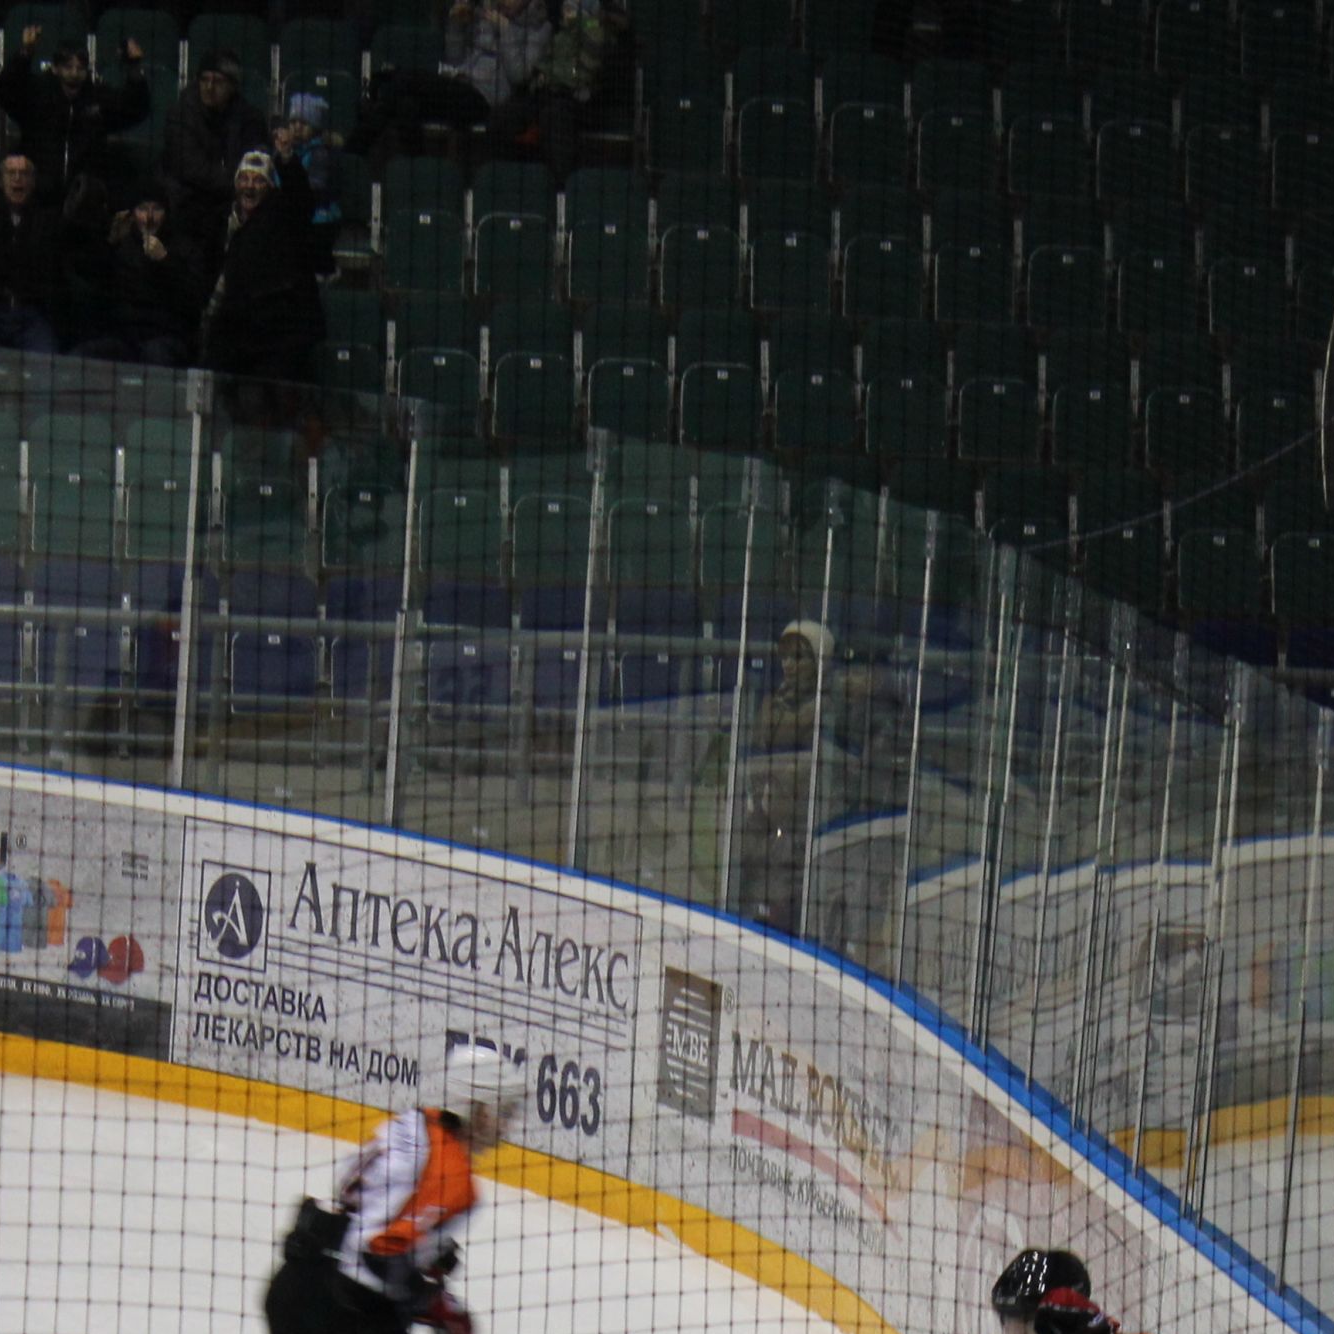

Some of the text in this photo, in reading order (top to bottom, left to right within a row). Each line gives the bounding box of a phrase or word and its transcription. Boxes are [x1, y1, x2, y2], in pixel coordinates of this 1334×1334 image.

[194, 972, 327, 1023] ДОСТАВКА
[193, 1012, 418, 1086] ЛЕКАРСТВ НА ДОМ
[536, 1053, 600, 1136] 663
